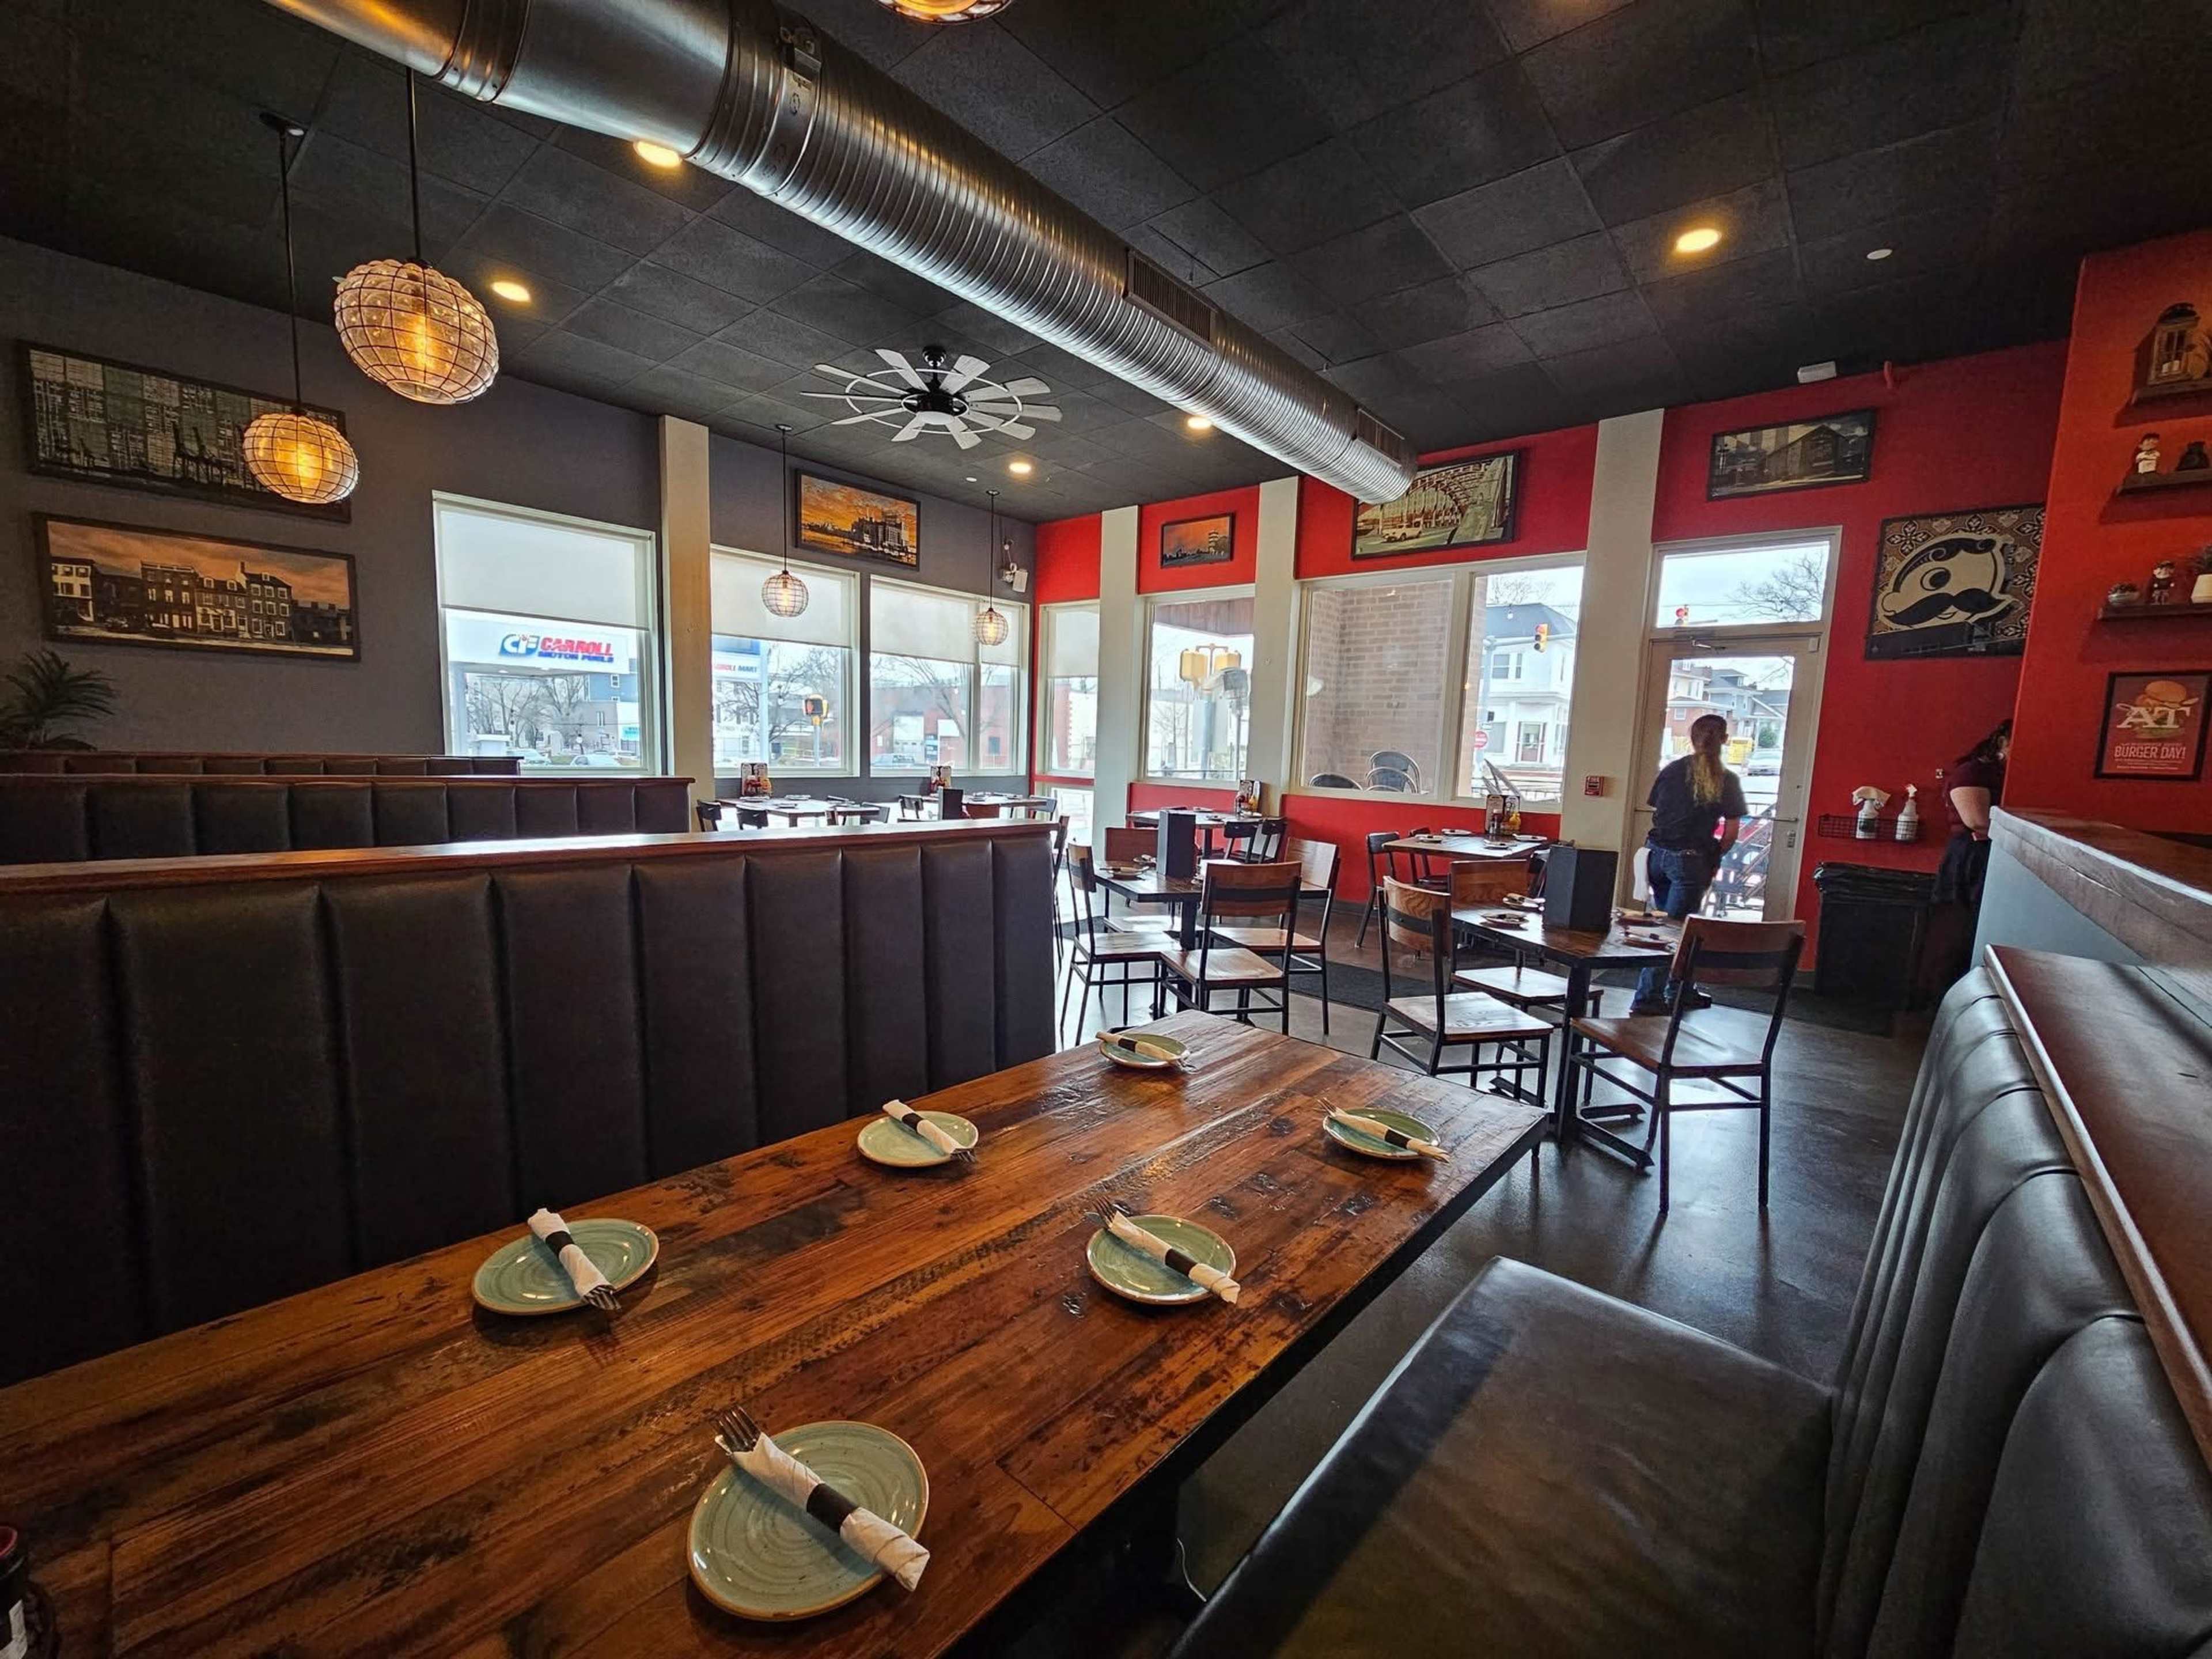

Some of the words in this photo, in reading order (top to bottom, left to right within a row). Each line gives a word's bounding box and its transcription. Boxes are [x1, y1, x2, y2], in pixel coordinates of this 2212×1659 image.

[540, 637, 613, 656] CARROLL
[2113, 745, 2158, 759] BURGER
[2160, 747, 2187, 759] DAY!
